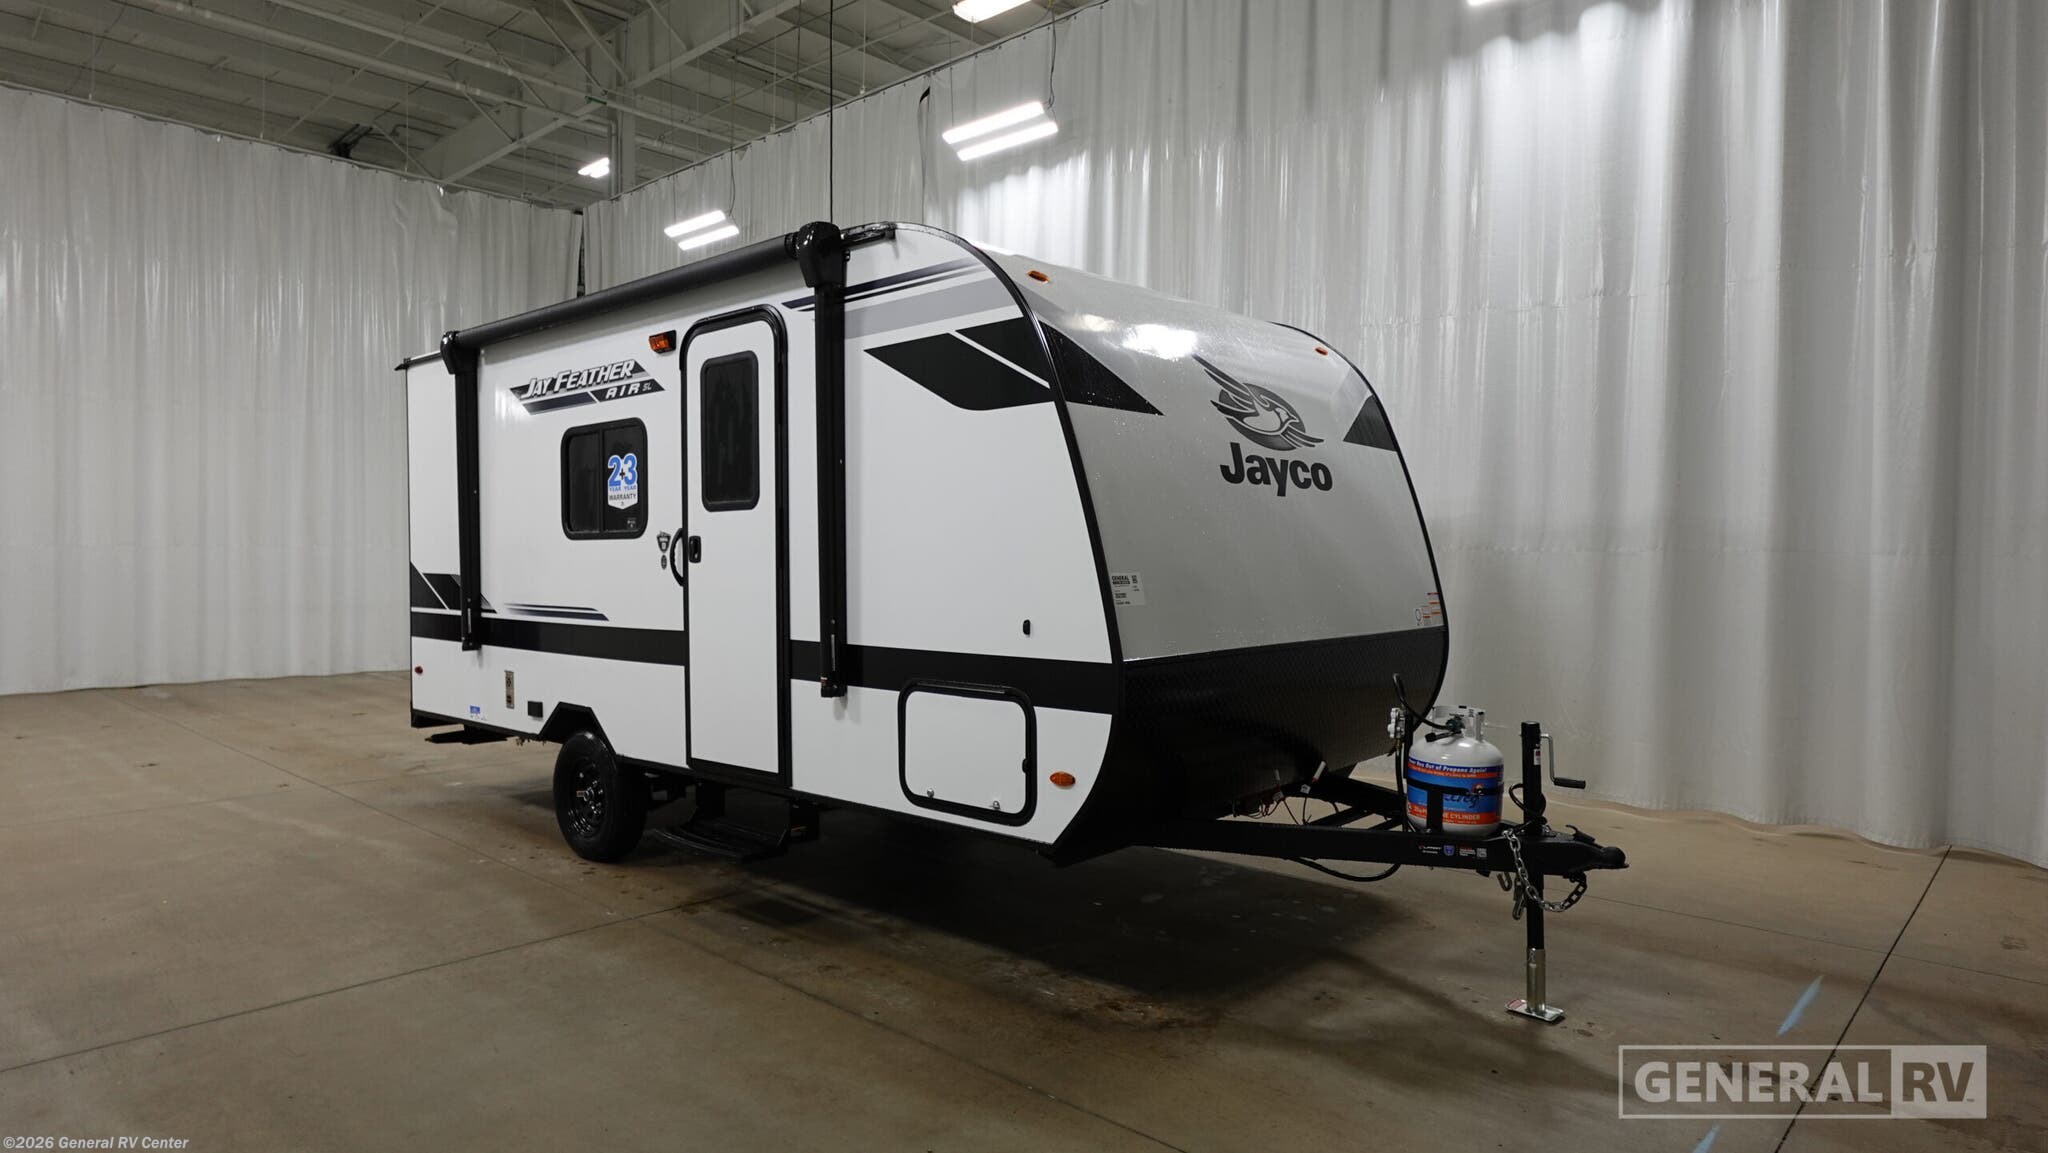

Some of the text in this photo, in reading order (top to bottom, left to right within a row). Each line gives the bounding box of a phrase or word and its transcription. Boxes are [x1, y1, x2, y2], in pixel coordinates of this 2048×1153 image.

[521, 359, 635, 399] JAY FEATHER
[605, 382, 652, 399] AIR SL
[1220, 442, 1333, 497] Jayco
[609, 493, 636, 501] WARRANTY
